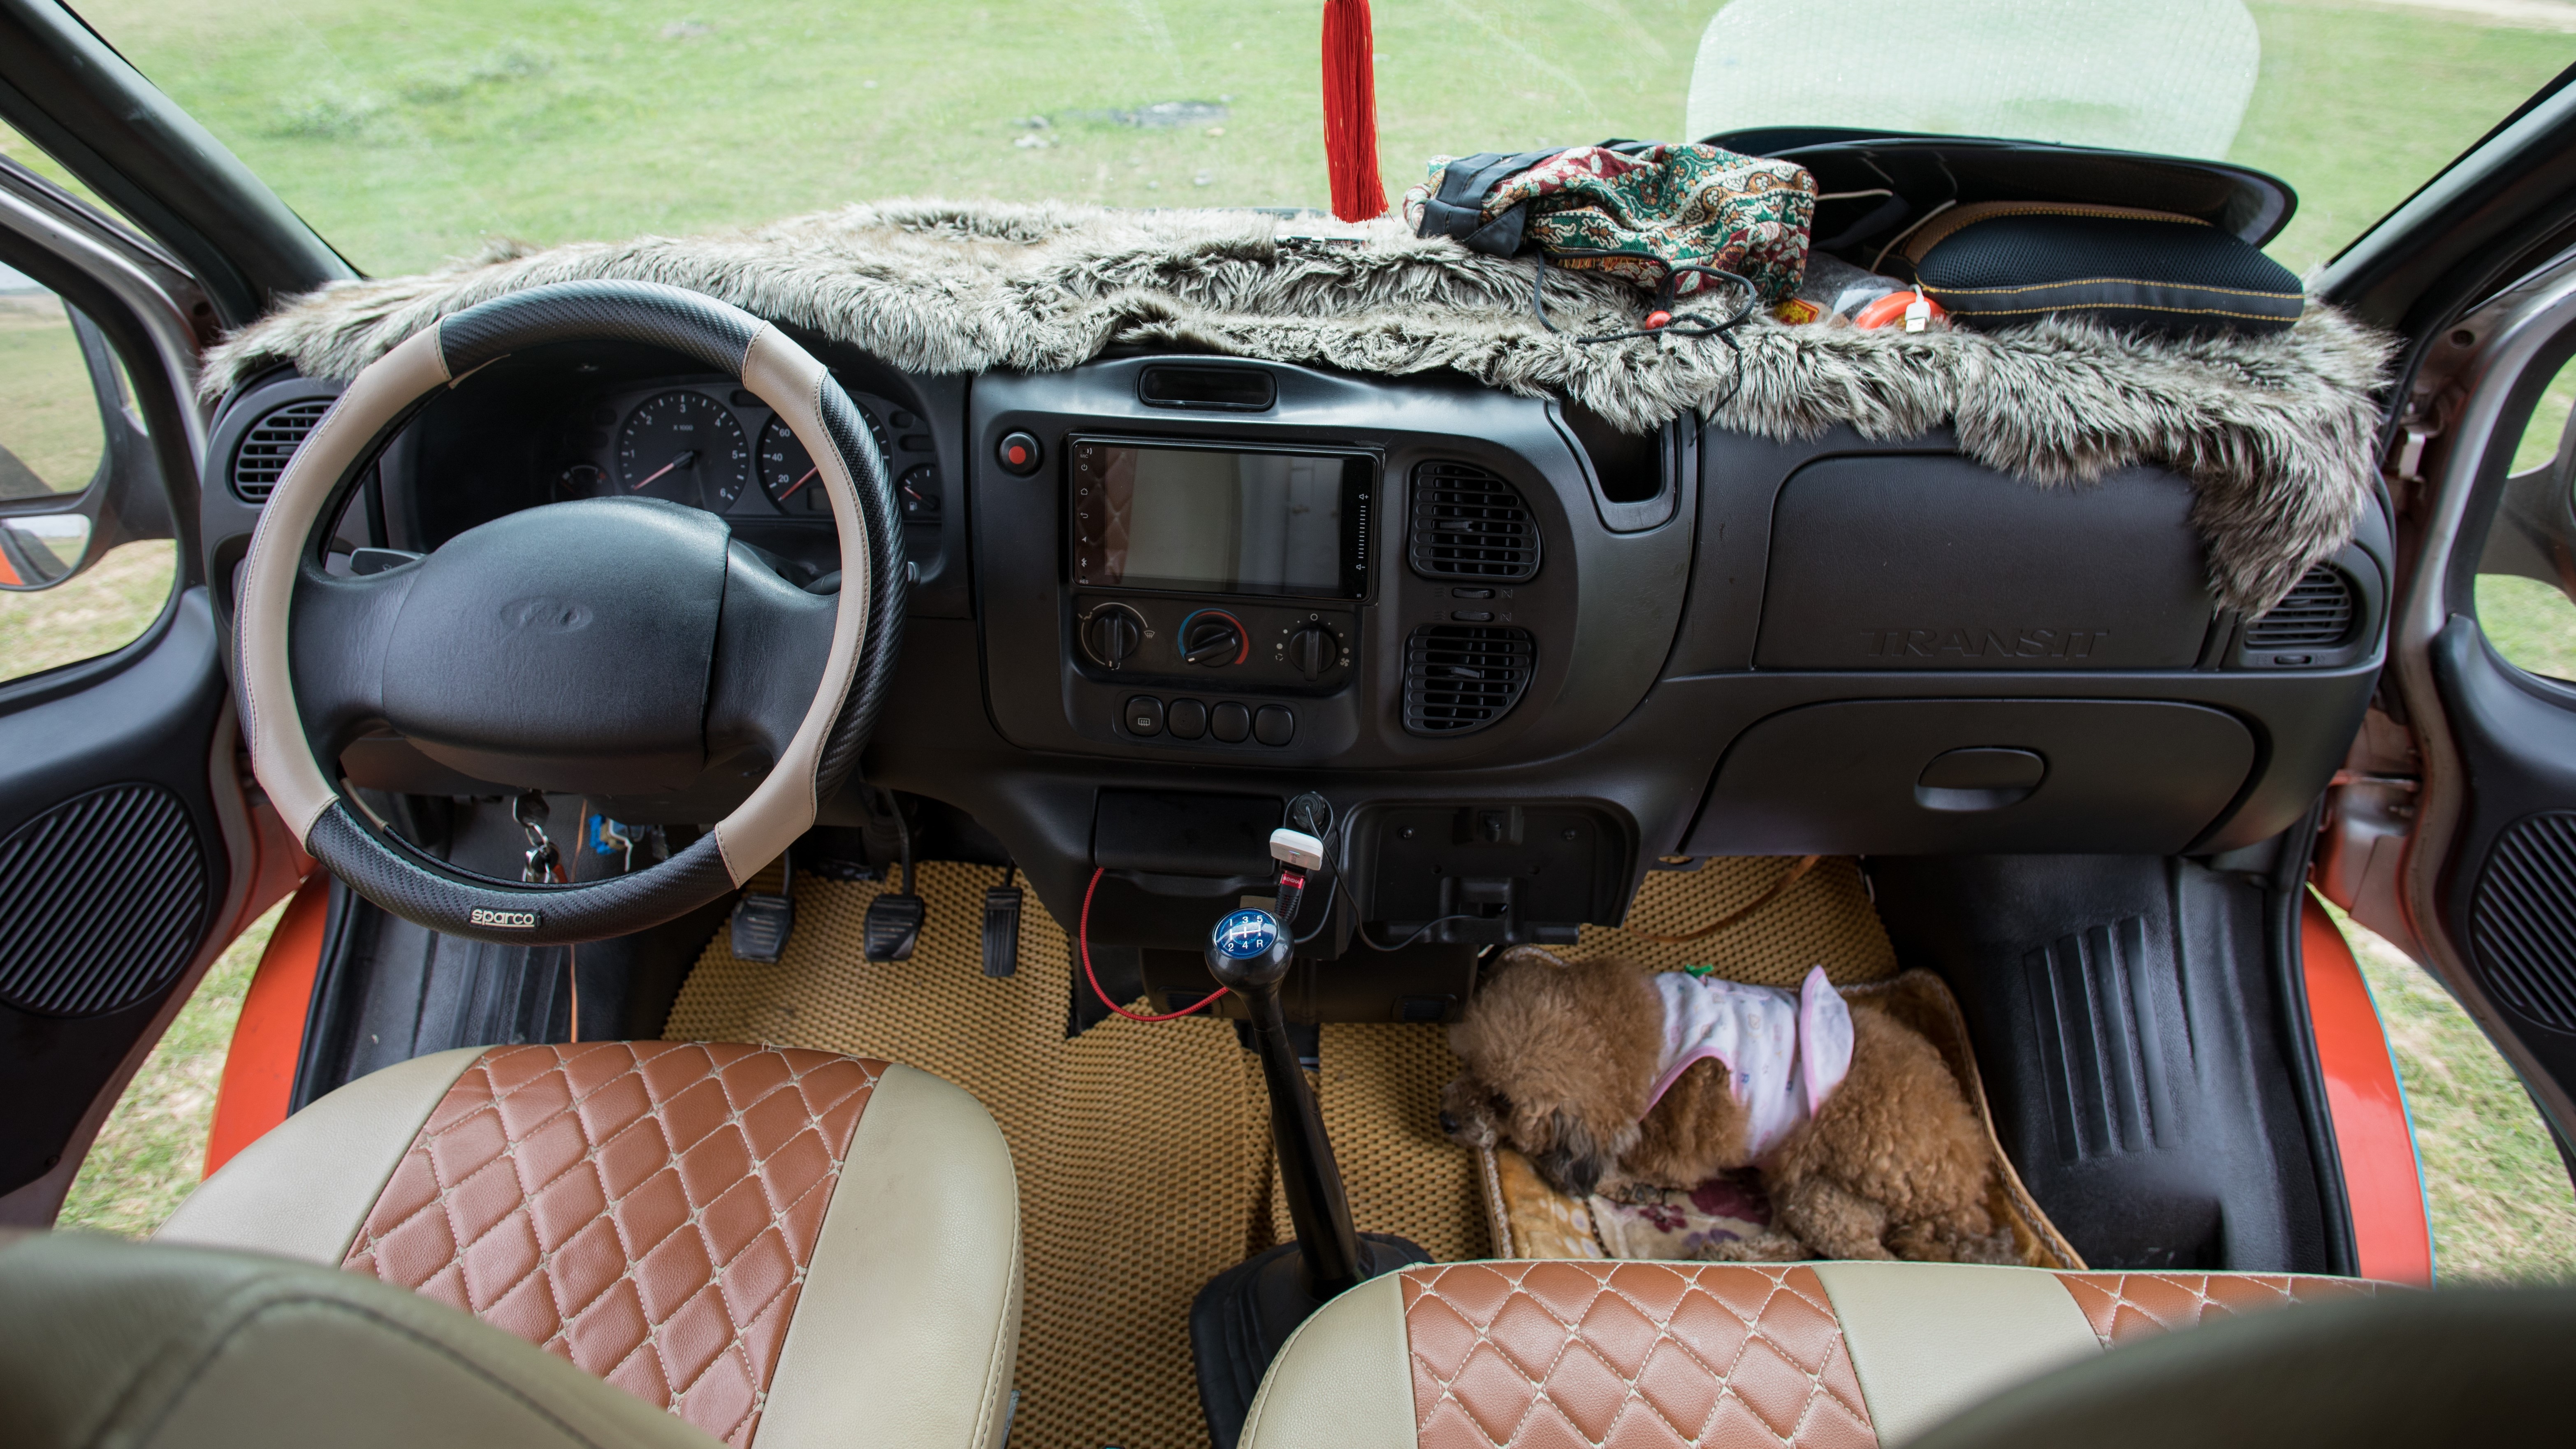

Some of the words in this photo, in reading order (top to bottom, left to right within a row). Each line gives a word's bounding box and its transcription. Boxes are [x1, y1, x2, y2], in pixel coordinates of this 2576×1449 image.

[680, 404, 686, 413] 3
[646, 415, 652, 425] 2
[715, 418, 721, 427] 4
[779, 429, 791, 437] 60
[631, 449, 635, 458] 1
[732, 450, 738, 459] 5
[772, 453, 783, 461] 40
[778, 474, 789, 483] 20
[720, 488, 726, 497] 6
[1860, 628, 2110, 658] TRANSIT
[472, 909, 534, 925] sparco
[1228, 943, 1234, 952] 2
[1242, 941, 1248, 949] 4
[1257, 939, 1263, 948] R
